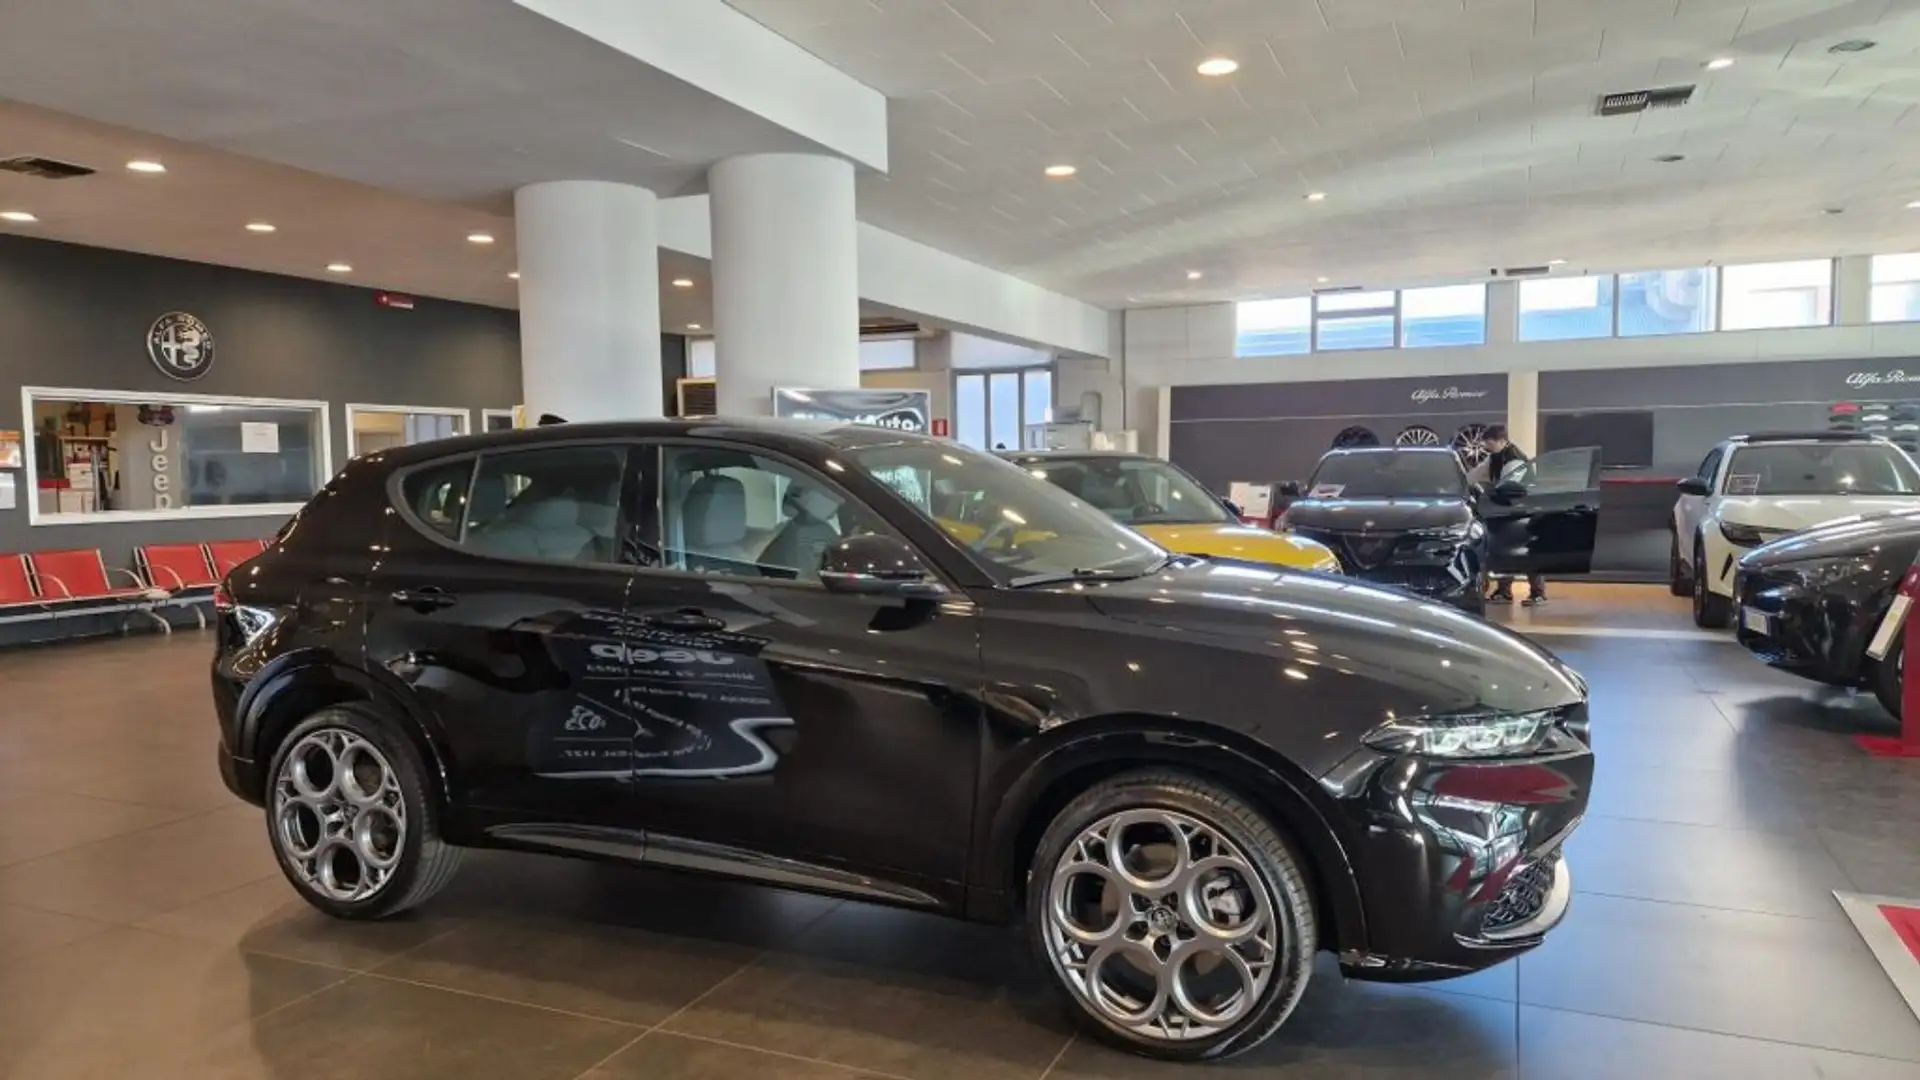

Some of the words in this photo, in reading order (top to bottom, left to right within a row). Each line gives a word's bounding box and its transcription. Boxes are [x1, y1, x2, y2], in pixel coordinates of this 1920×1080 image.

[1846, 371, 1882, 389] Alfa
[1410, 387, 1440, 404] Alfa
[1443, 386, 1489, 399] Romeo
[149, 429, 173, 511] Jeep
